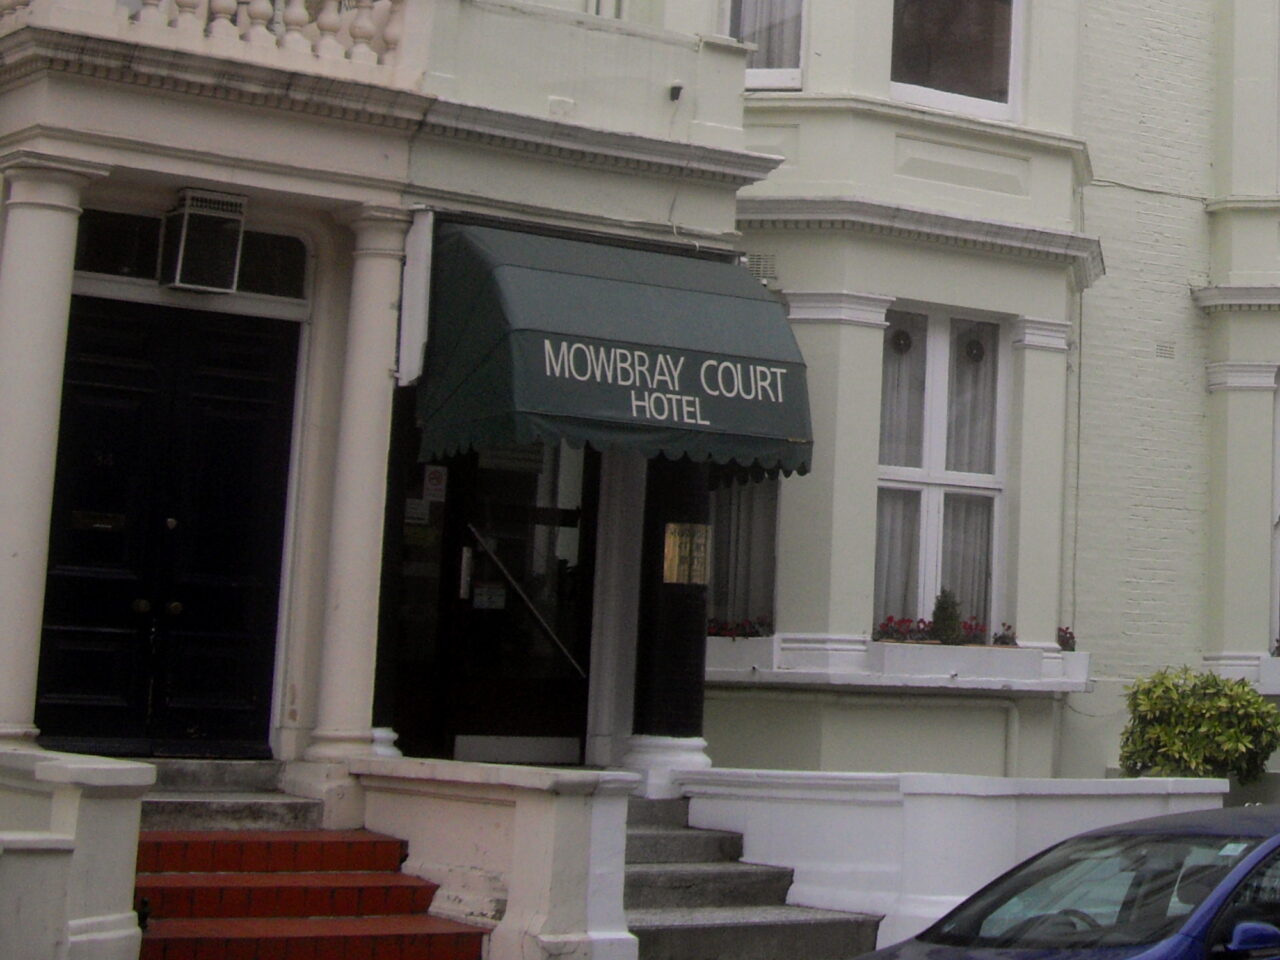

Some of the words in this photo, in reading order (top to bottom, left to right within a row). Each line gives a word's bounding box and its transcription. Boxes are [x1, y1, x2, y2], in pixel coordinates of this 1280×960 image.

[544, 339, 684, 390] MOWBRAY
[701, 359, 786, 402] COURT
[631, 391, 710, 426] HOTEL
